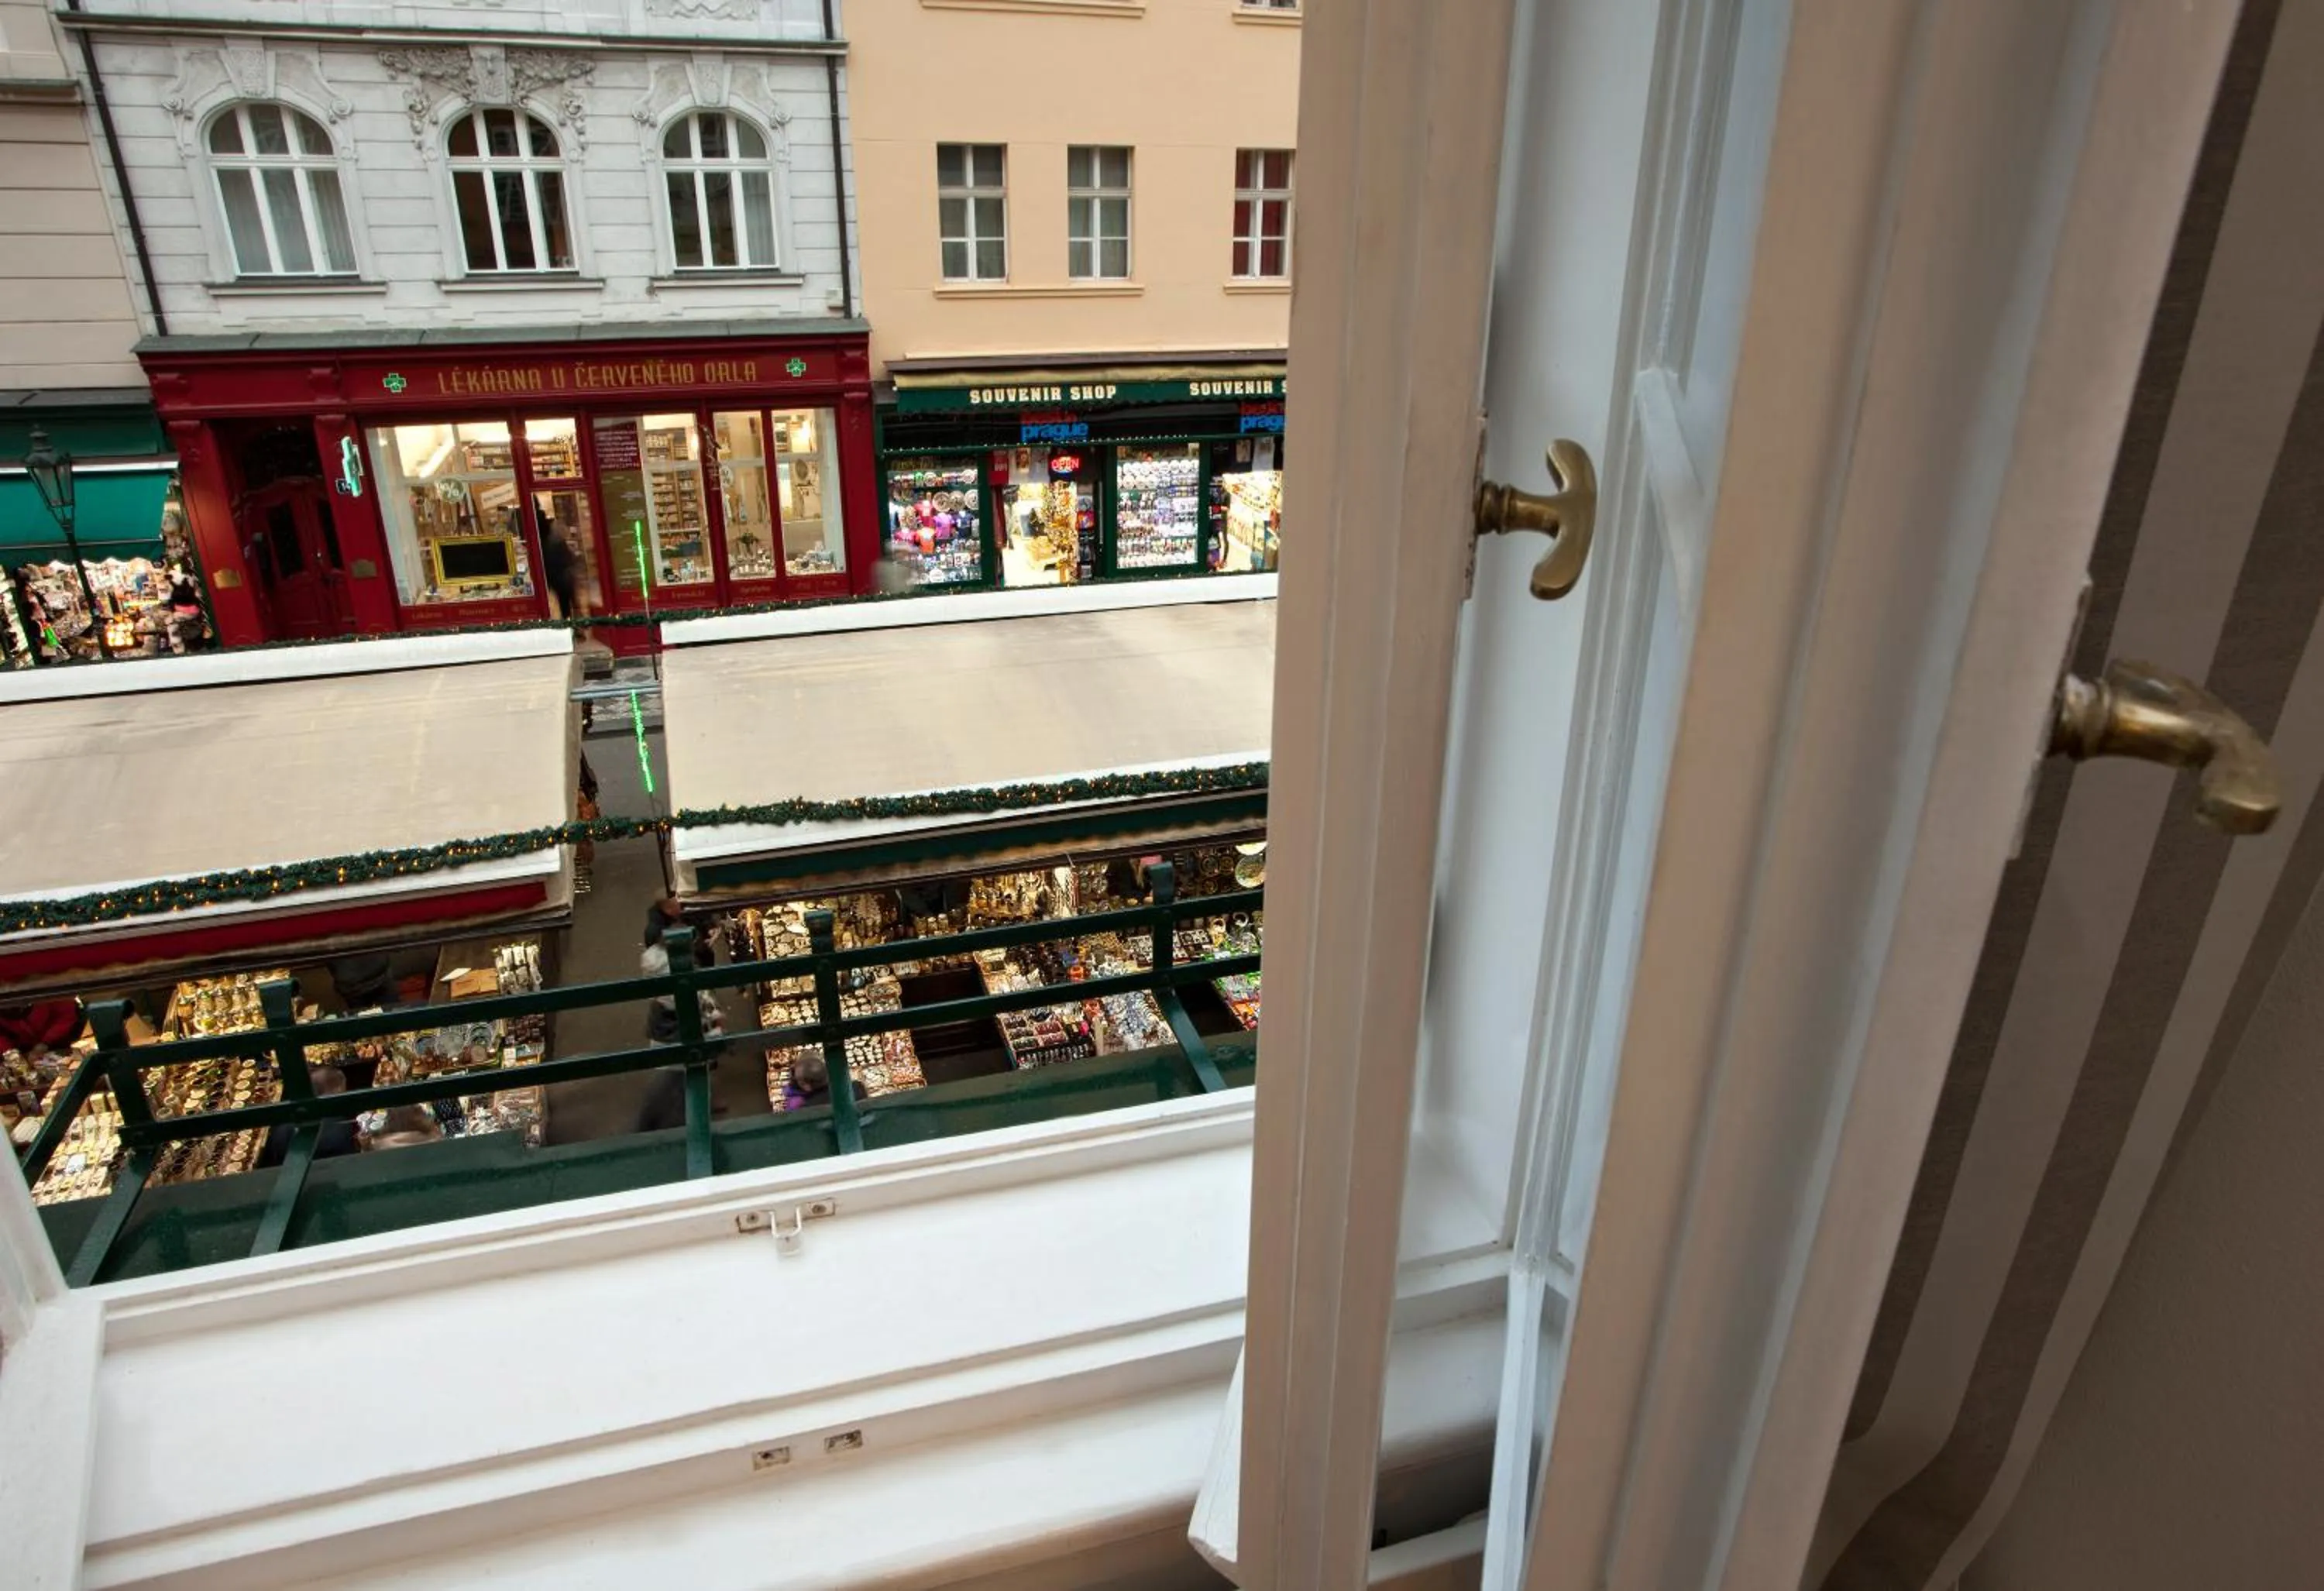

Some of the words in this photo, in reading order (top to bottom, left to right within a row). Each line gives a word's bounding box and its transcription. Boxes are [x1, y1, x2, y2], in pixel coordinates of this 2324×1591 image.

[438, 366, 542, 393] LÉKÁRNA
[552, 367, 564, 388] U
[575, 360, 695, 387] ČERVENÉHO
[704, 362, 756, 383] ORLA
[970, 387, 1061, 404] SOUVENIR
[1070, 385, 1116, 400] SHOP
[1189, 380, 1273, 396] SOUVENIR
[1021, 422, 1088, 442] prague
[1051, 456, 1080, 472] OPEN
